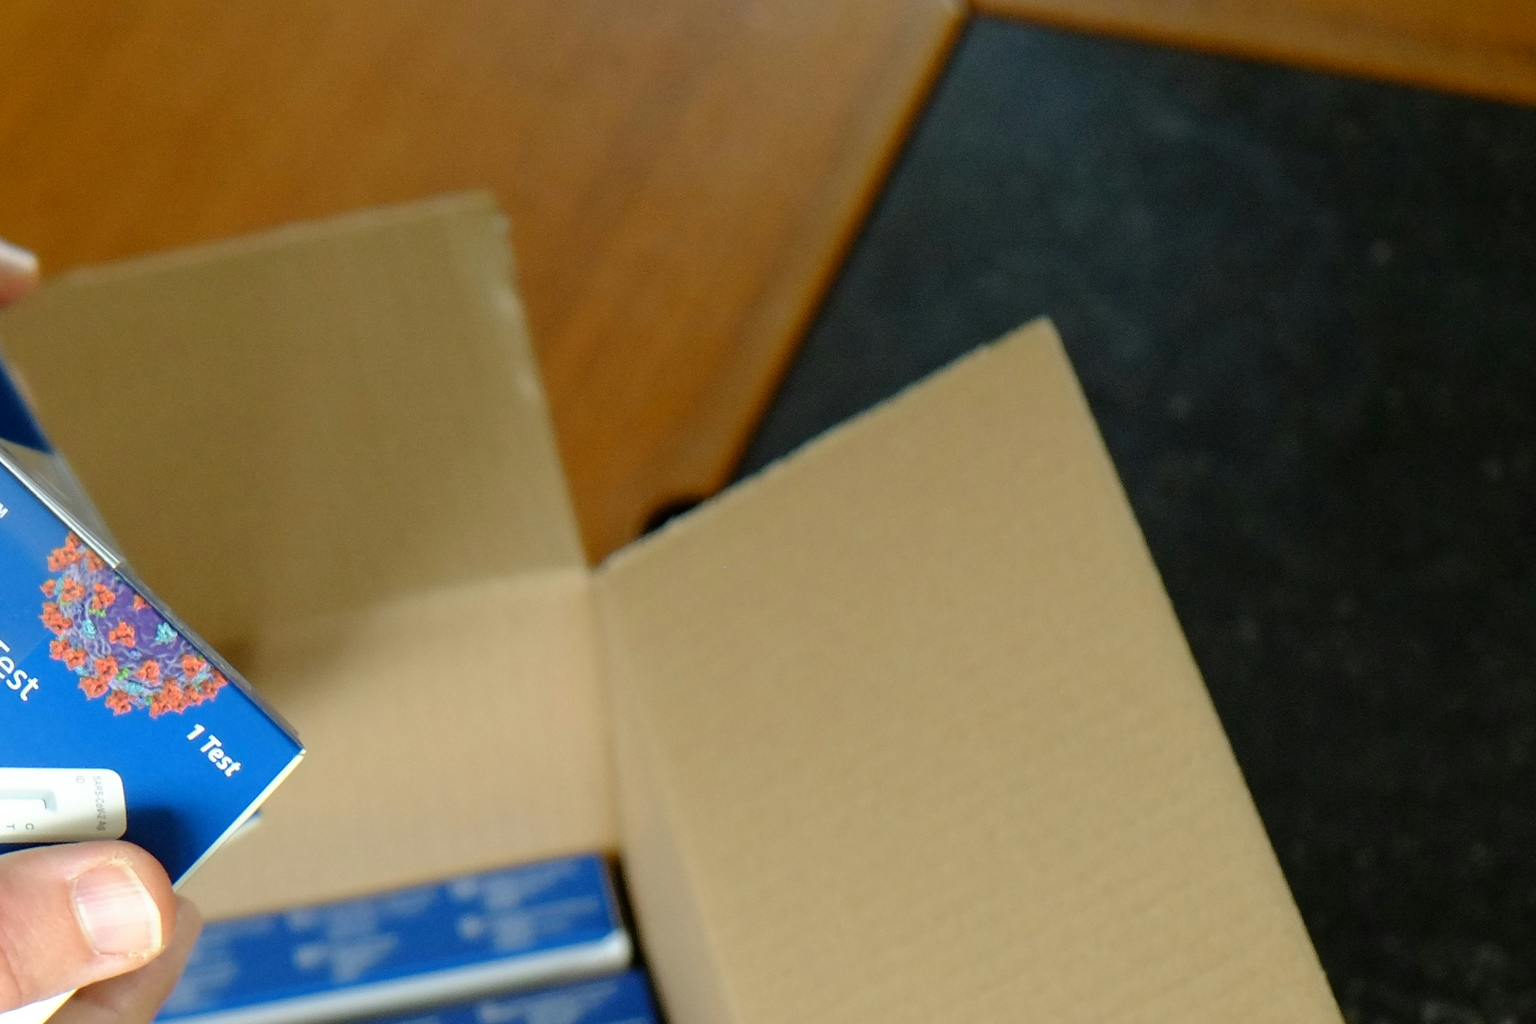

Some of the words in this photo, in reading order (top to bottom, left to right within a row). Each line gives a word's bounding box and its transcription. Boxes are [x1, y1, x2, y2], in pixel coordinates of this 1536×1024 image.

[187, 724, 205, 740] 1
[200, 734, 241, 777] Test
[5, 823, 16, 831] T
[25, 822, 35, 831] C
